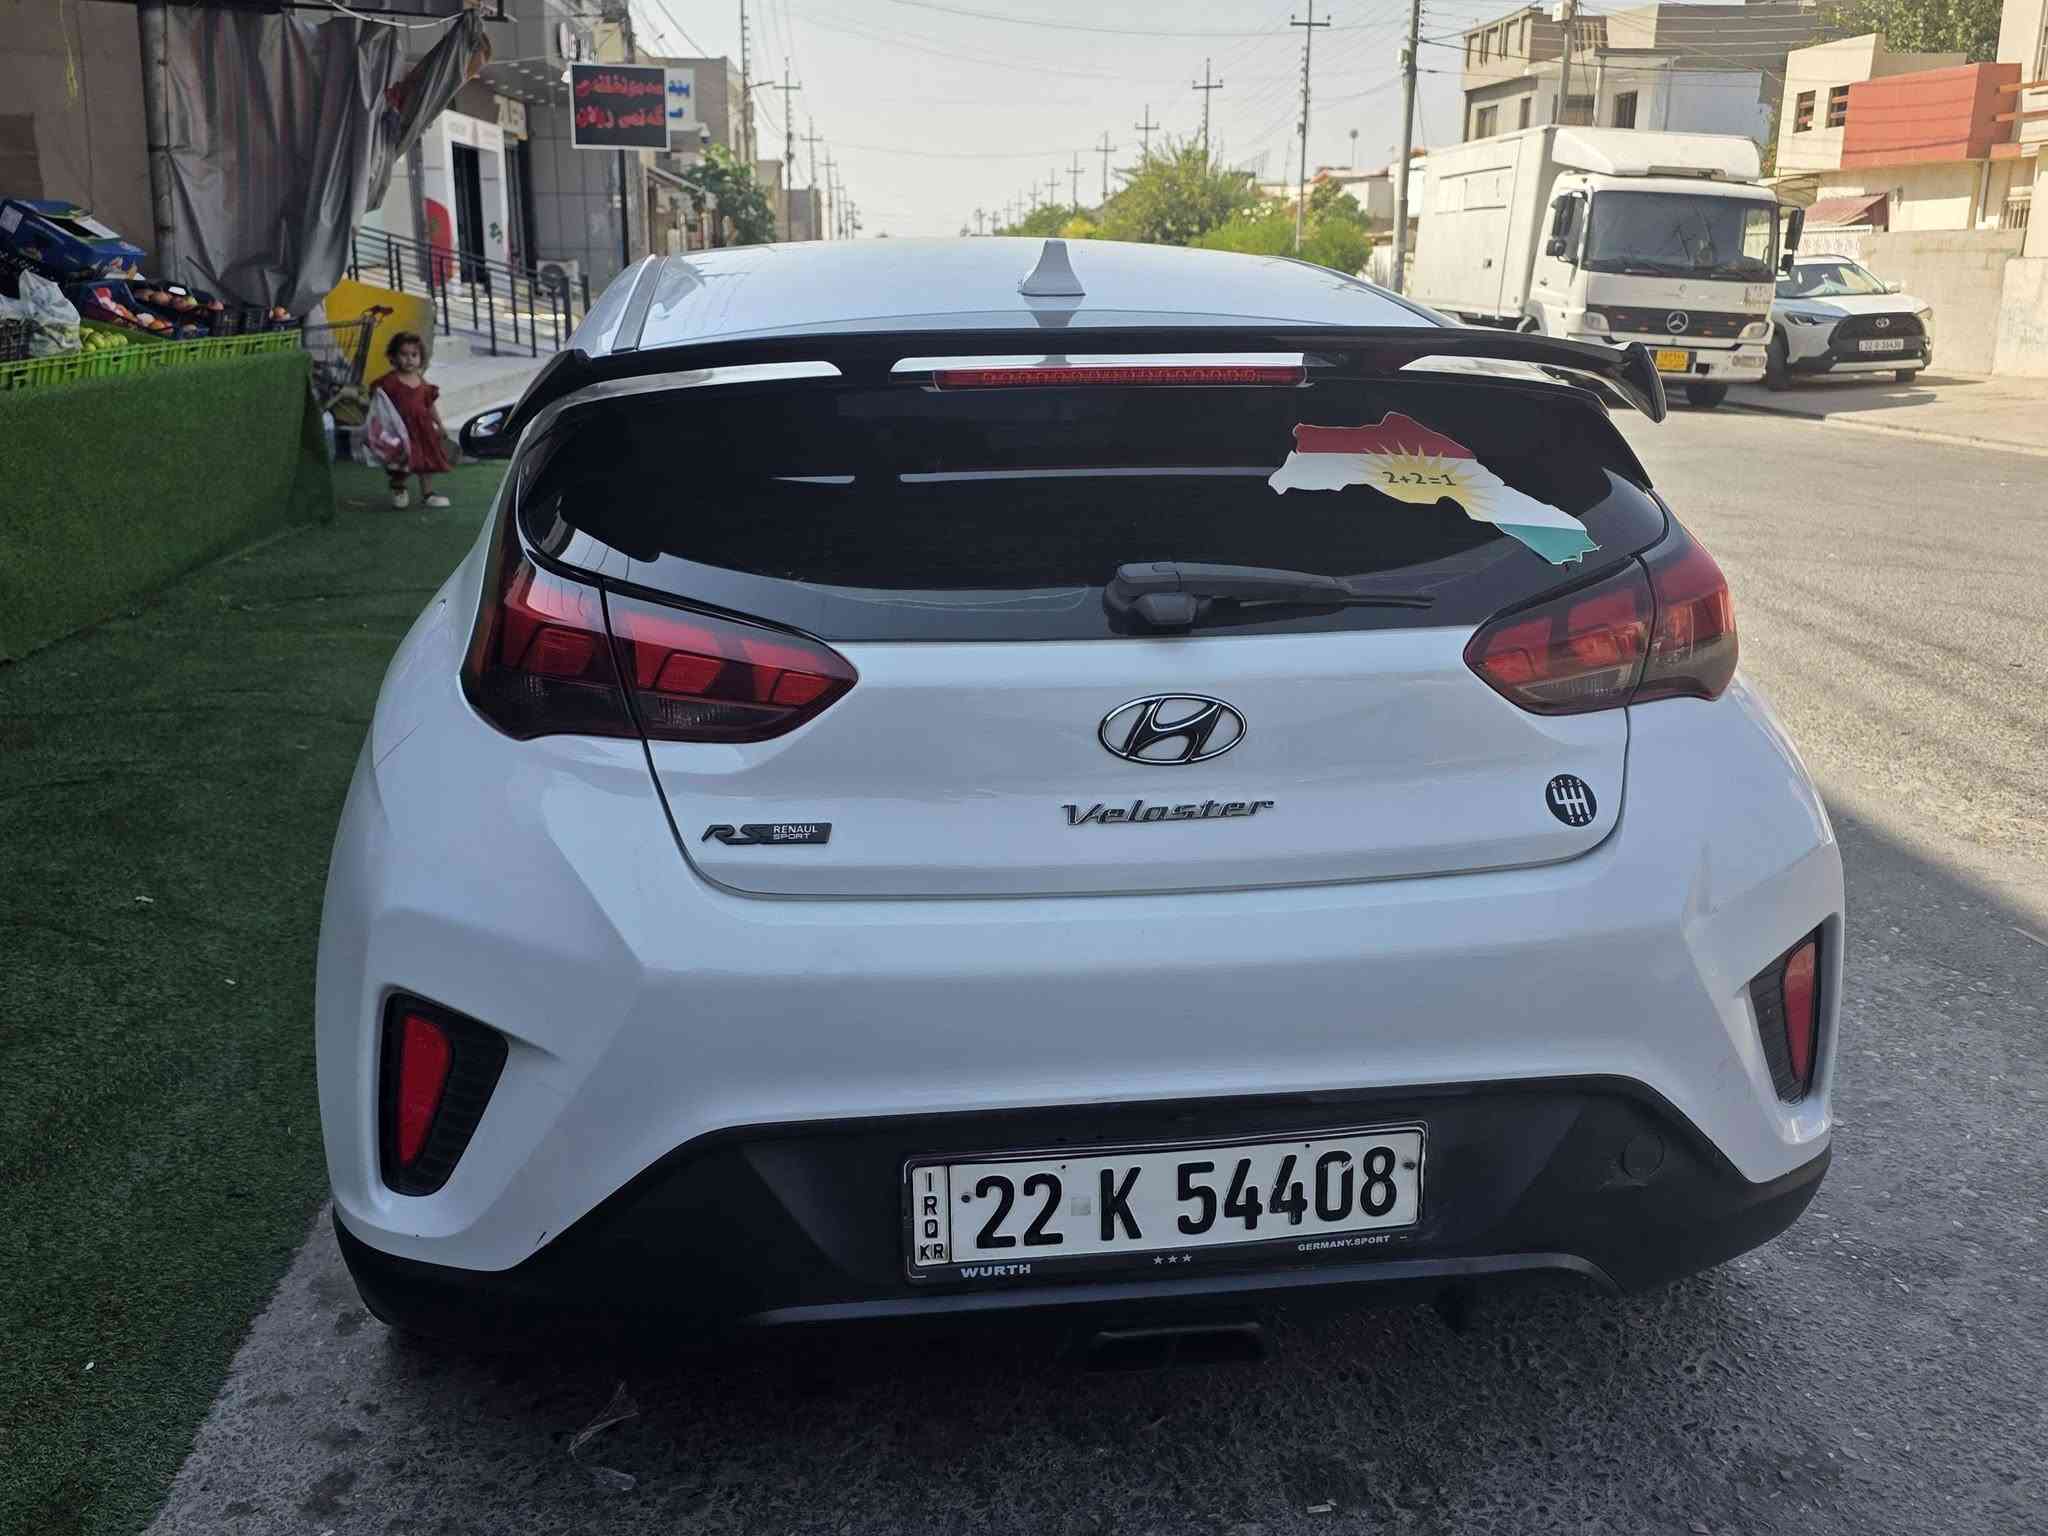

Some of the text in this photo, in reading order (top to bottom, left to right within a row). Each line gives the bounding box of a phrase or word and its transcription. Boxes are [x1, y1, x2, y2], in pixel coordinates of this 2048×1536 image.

[1382, 471, 1457, 486] 2+2=1
[1061, 799, 1274, 825] Veloster
[773, 825, 818, 833] RENAUL
[975, 1146, 1397, 1249] 22 K 54408
[919, 1243, 944, 1260] KR
[960, 1264, 1031, 1278] WURTH
